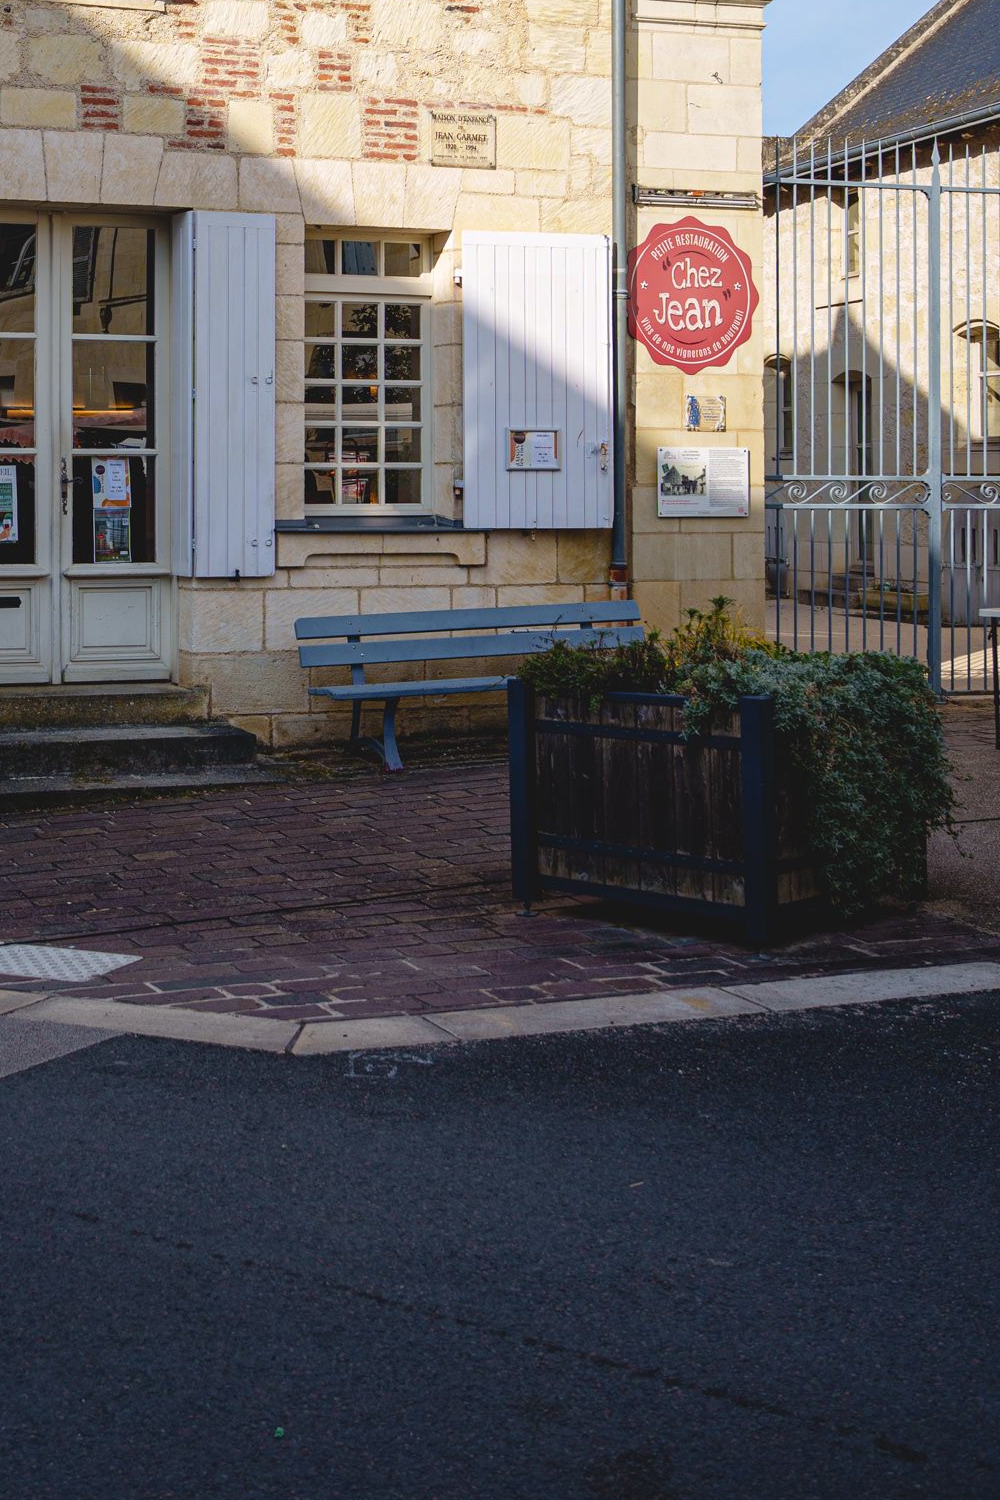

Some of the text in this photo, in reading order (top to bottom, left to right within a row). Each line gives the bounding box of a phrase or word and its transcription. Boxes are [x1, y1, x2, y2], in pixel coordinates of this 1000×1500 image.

[432, 113, 490, 123] MAISON D'ENFANCE
[435, 131, 454, 140] JEAN
[650, 233, 730, 263] PETITE RESTAURATION
[652, 333, 662, 345] de
[661, 341, 675, 354] nos
[676, 346, 713, 359] vignerons
[712, 341, 722, 352] de
[720, 309, 745, 345] Bourgueil
